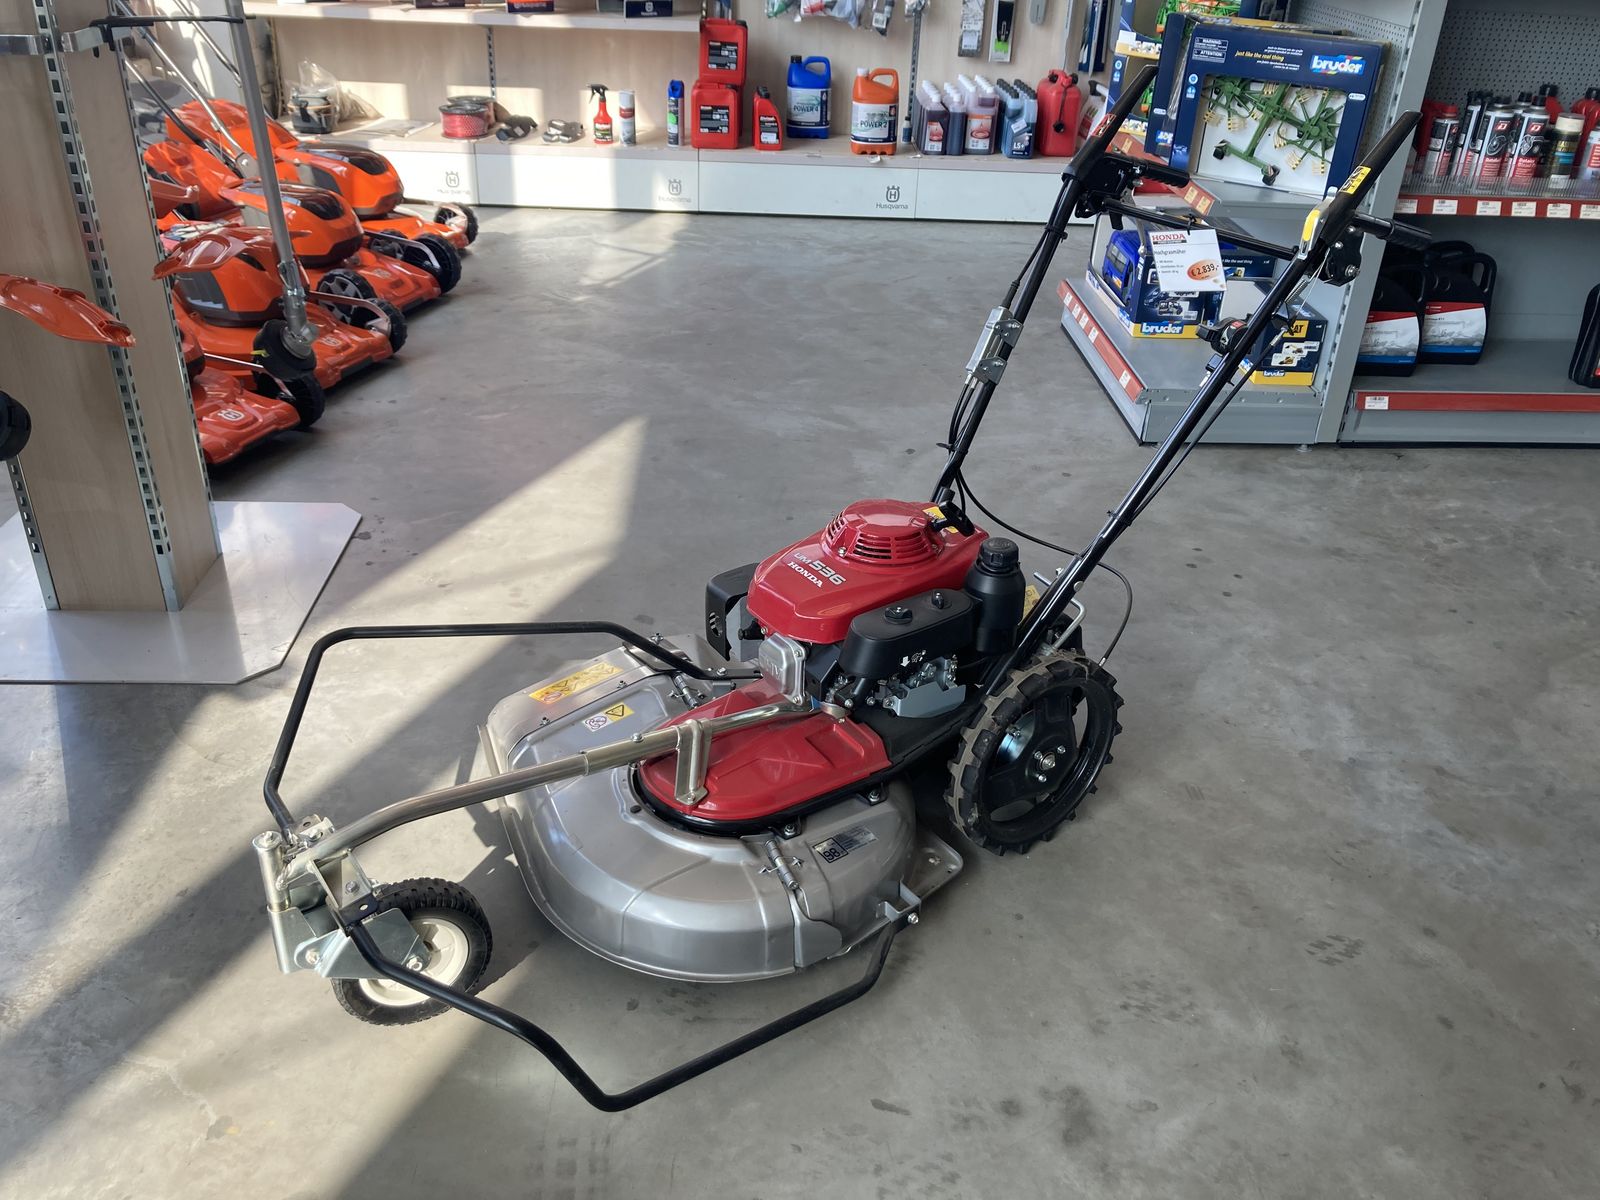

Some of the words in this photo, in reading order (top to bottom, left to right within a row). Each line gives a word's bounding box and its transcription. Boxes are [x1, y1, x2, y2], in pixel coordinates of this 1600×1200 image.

[1272, 54, 1284, 62] thing
[1312, 56, 1362, 73] bruder
[875, 202, 909, 210] Husqvarna
[1152, 233, 1186, 241] HONDA
[1142, 322, 1182, 334] bruder
[787, 561, 823, 588] HONDA
[823, 847, 841, 861] 98
